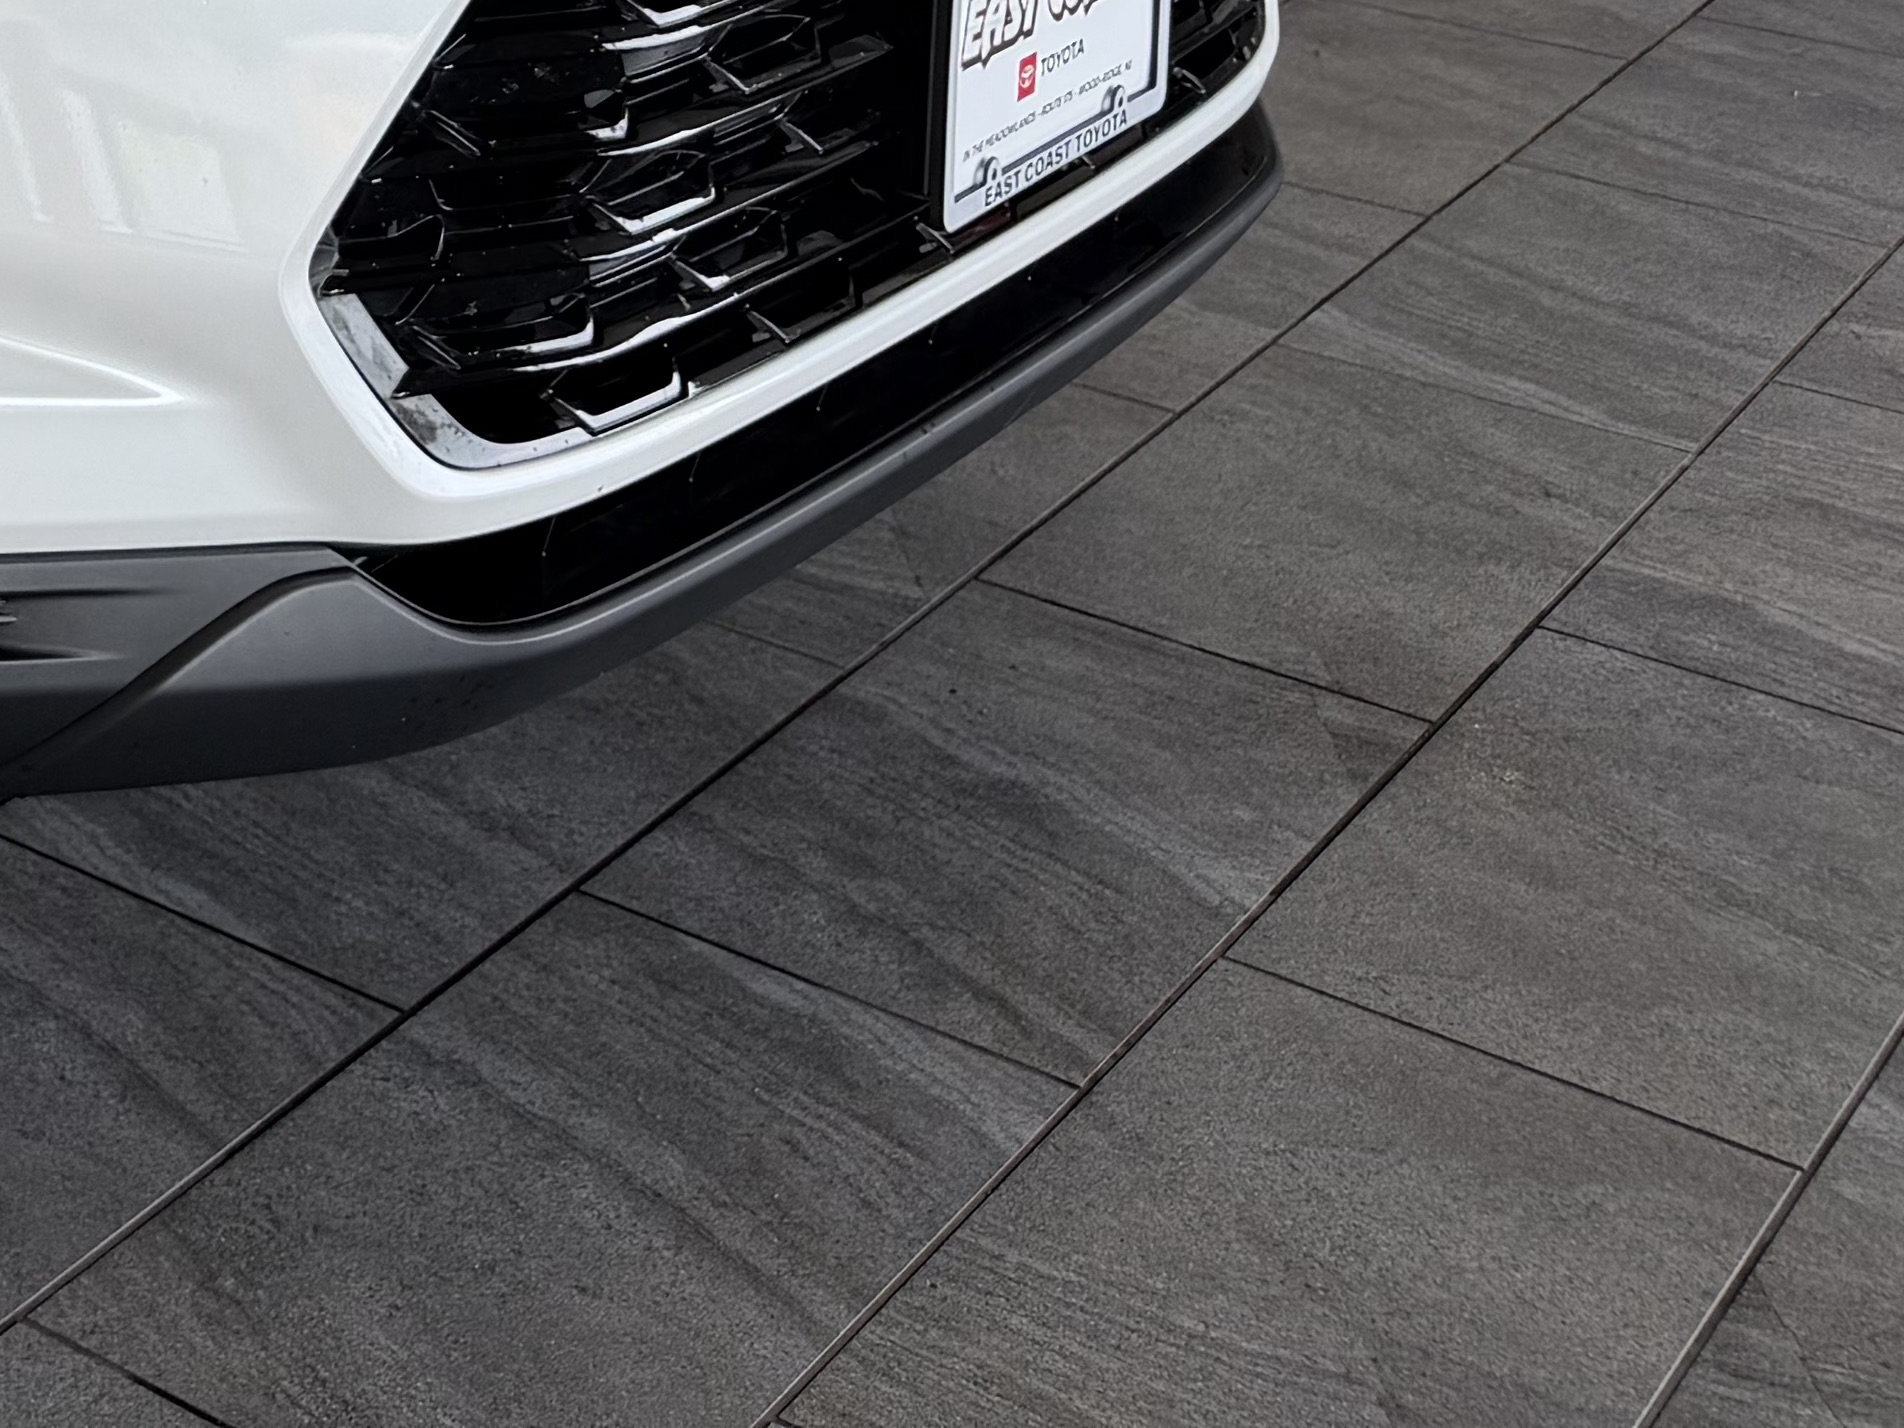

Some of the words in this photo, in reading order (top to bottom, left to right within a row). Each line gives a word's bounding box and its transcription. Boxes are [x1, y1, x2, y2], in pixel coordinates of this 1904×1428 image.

[1041, 38, 1085, 76] TOYOTA
[984, 168, 1023, 207] EAST
[1024, 142, 1073, 182] COAST
[1074, 109, 1128, 155] TOYOTA
